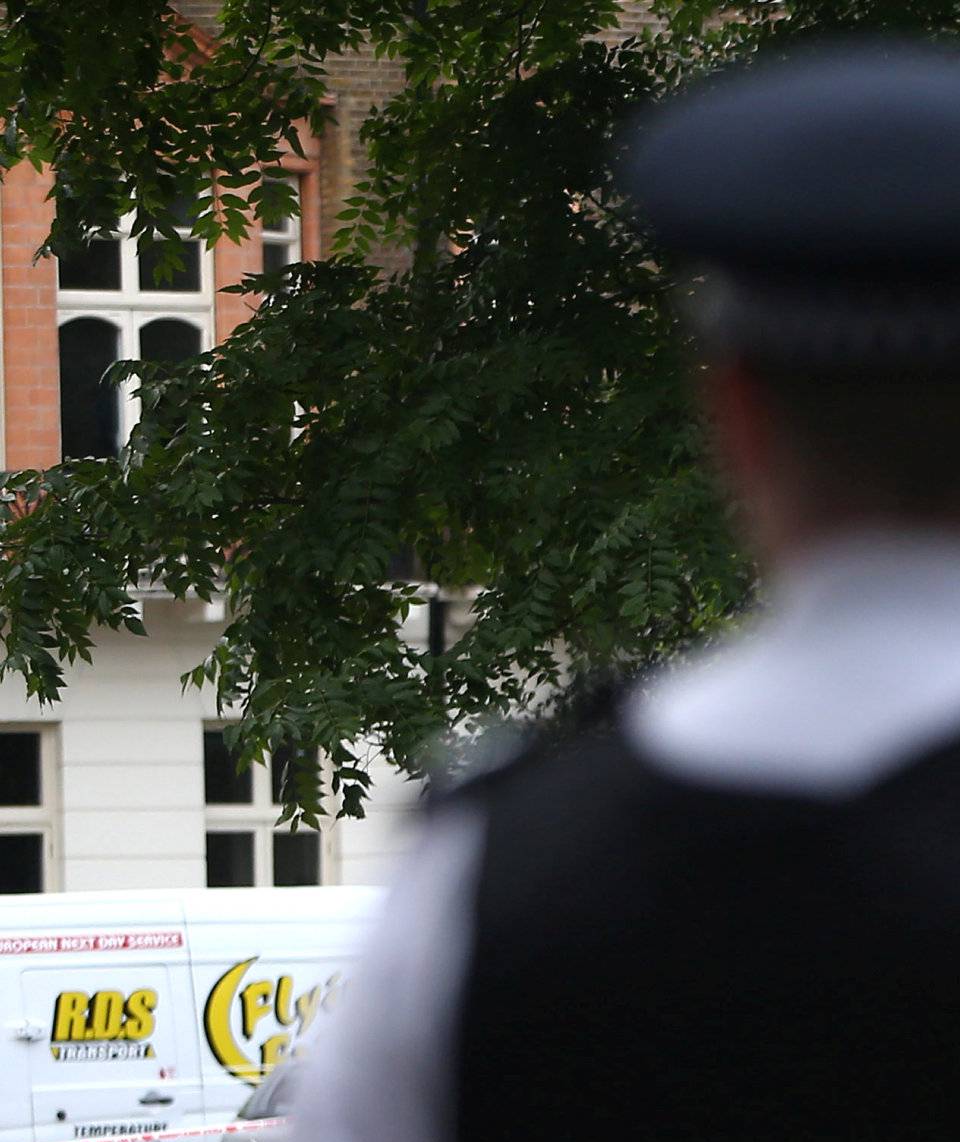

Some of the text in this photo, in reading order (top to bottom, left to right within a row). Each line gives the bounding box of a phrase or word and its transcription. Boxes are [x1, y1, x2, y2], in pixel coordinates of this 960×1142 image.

[61, 936, 95, 950] NEXT
[98, 934, 125, 948] DAY
[129, 932, 179, 947] SERVICE
[51, 990, 158, 1041] R.D.S
[60, 1043, 147, 1061] TRANSPORT
[75, 1124, 167, 1137] TEMPERATURE
